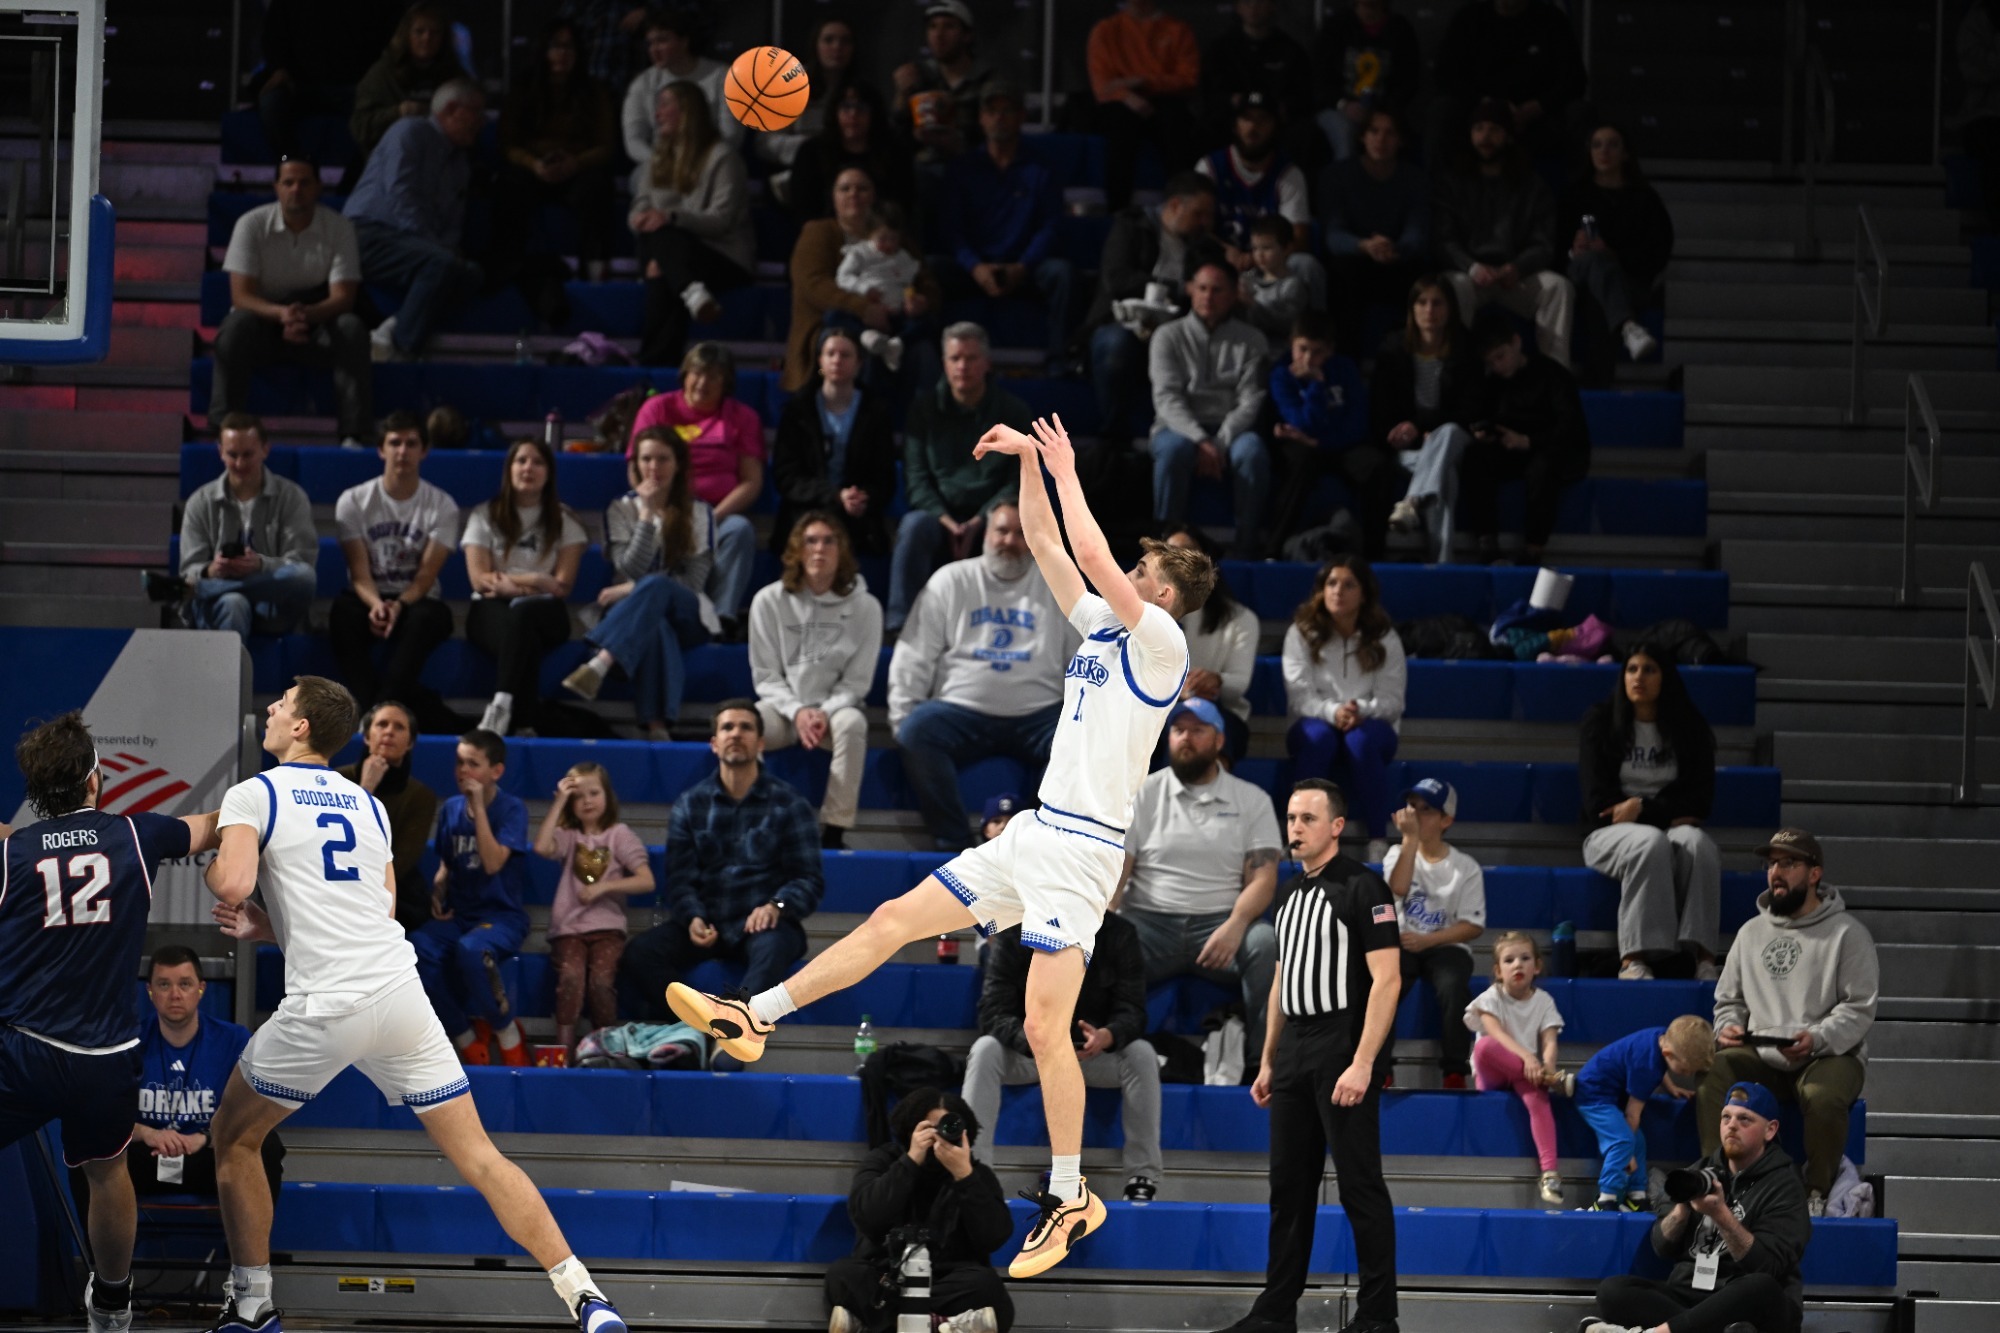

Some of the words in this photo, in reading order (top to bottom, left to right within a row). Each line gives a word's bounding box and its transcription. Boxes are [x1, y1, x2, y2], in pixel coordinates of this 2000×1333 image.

[970, 605, 1036, 631] DRAKE
[1065, 654, 1109, 687] Drke
[92, 735, 140, 745] resented
[292, 789, 359, 810] GOODBARY
[42, 829, 98, 850] ROGERS
[316, 812, 361, 881] 2
[35, 852, 112, 929] 12
[138, 1088, 214, 1114] DRAKE
[141, 1113, 210, 1121] BASKETBALL
